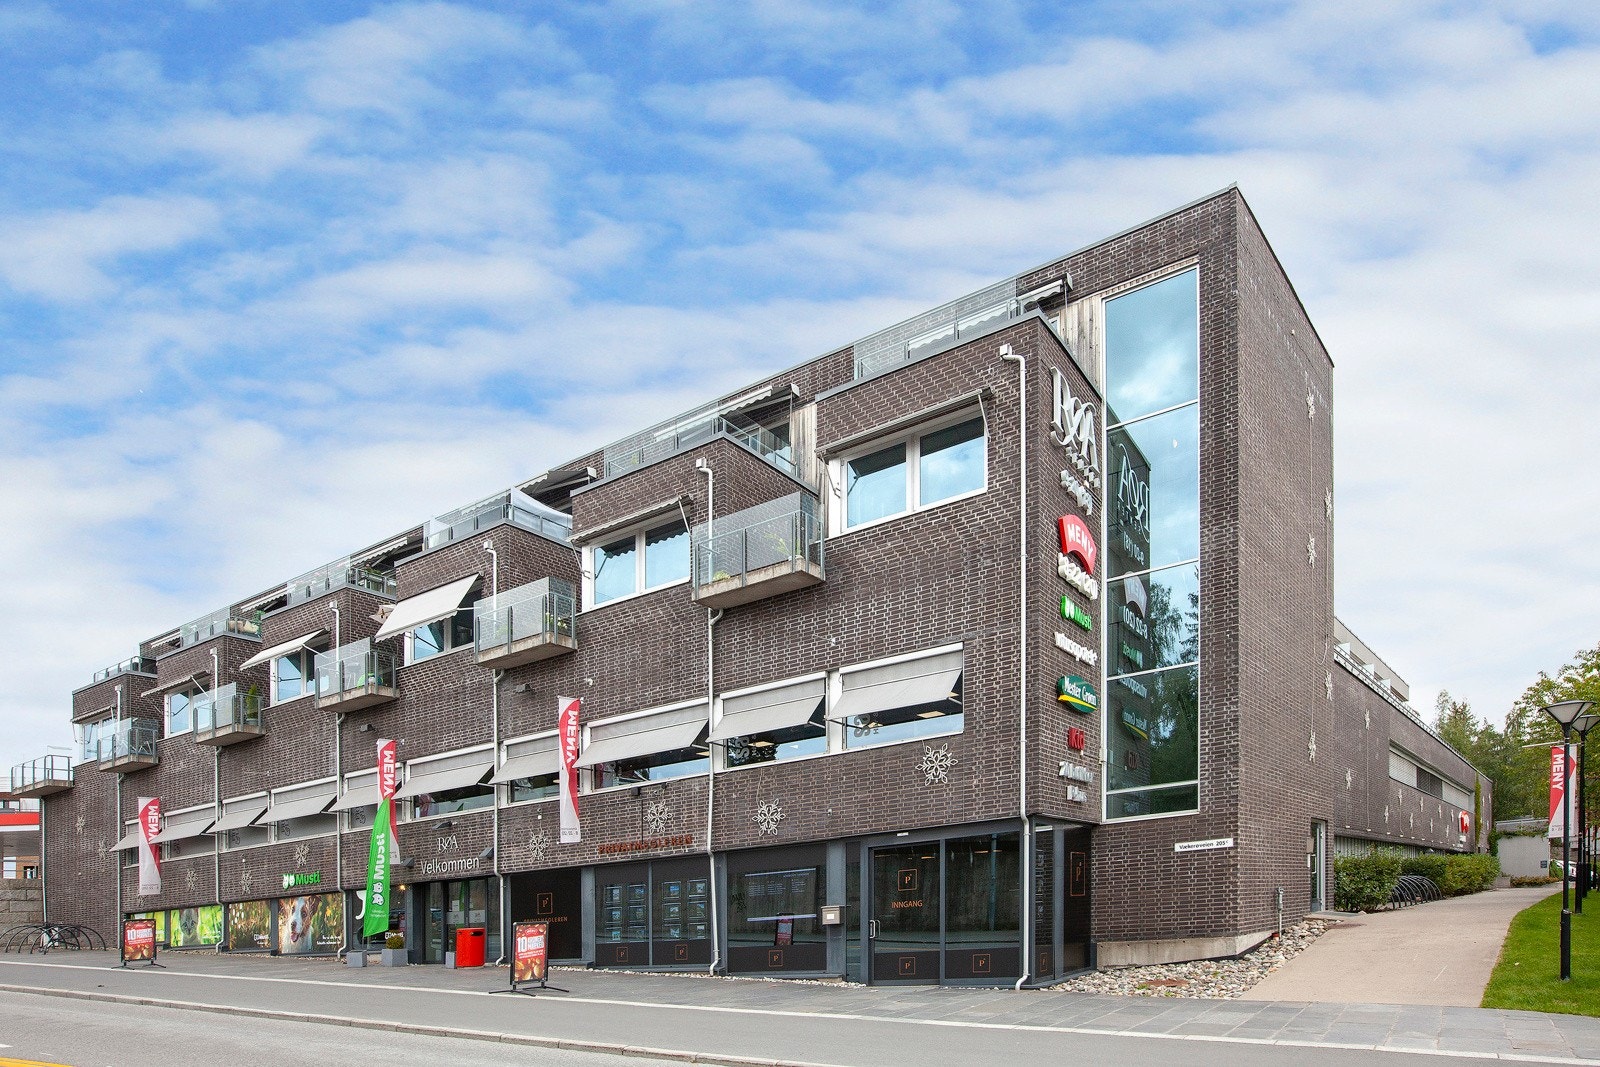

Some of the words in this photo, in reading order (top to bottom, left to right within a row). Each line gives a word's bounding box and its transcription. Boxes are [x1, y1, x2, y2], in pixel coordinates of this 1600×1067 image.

[1067, 523, 1094, 558] MENY
[1065, 676, 1082, 699] Mester
[1068, 726, 1085, 751] Kid
[1553, 753, 1565, 791] MENY
[437, 834, 460, 853] RØA
[1179, 842, 1214, 850] Vækerøveien
[374, 833, 385, 880] Musti
[420, 857, 480, 875] Velkommen
[295, 870, 321, 885] Musti
[891, 899, 923, 909] INNGANG
[517, 936, 528, 953] 10
